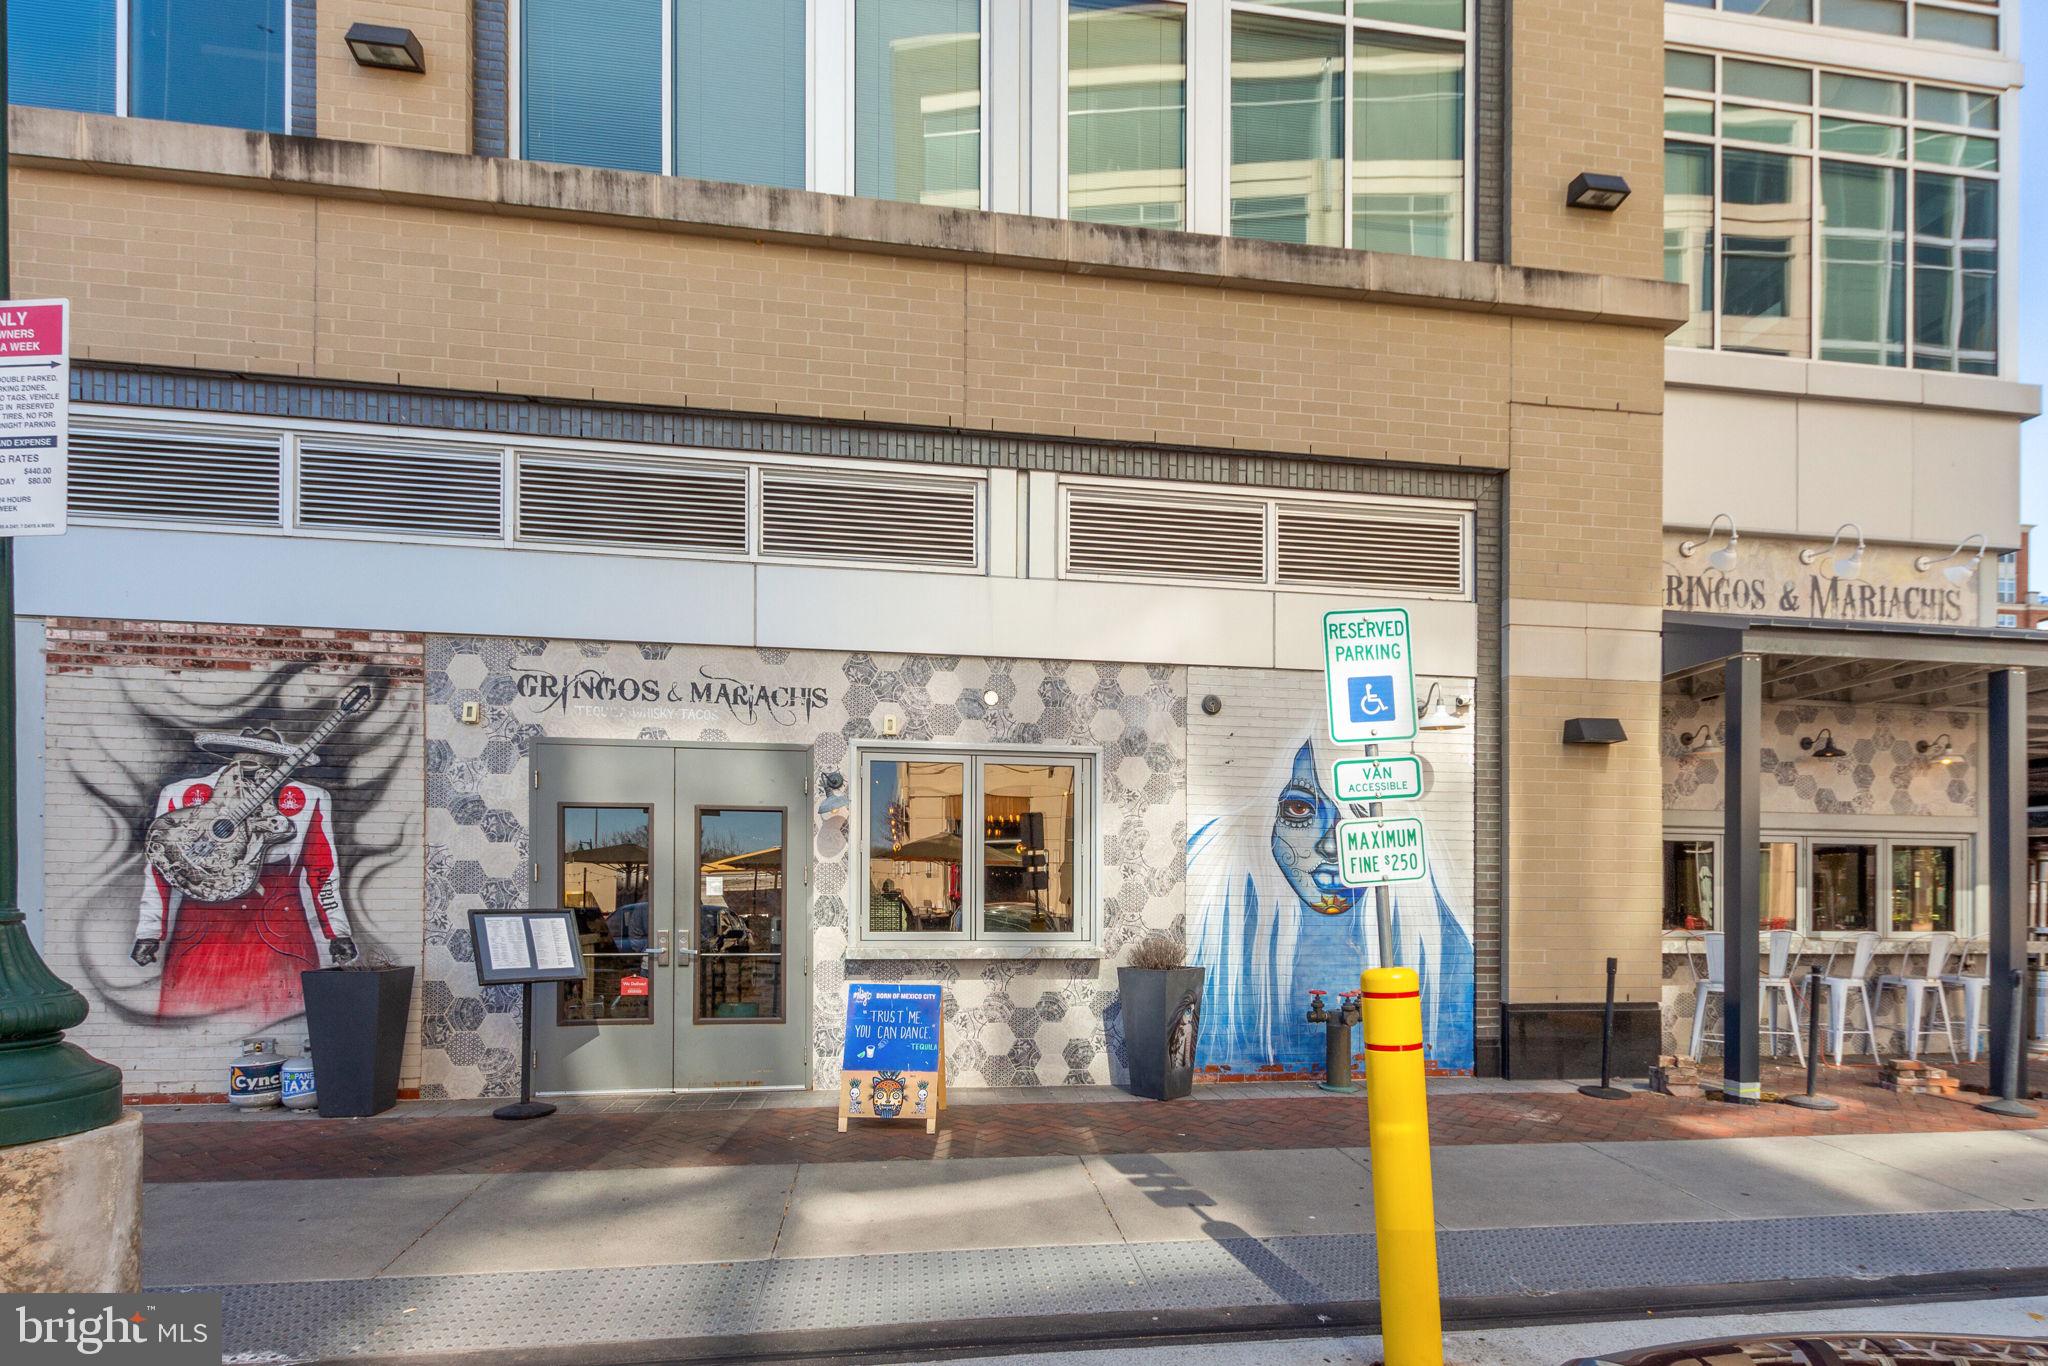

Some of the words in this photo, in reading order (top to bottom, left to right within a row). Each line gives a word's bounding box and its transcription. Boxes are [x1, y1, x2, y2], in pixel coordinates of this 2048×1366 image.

[1, 342, 8, 352] A
[10, 341, 40, 351] WEEK
[0, 375, 25, 383] OUBLE
[29, 392, 60, 400] VEHICLE
[17, 402, 55, 410] RESERVED
[39, 411, 53, 419] FOR
[24, 420, 56, 428] PARKING
[14, 438, 52, 447] EXPENSE
[8, 454, 40, 463] RATES
[24, 467, 52, 475] $440.00
[1662, 563, 1767, 613] RINGOS
[1779, 579, 1800, 612] &
[1329, 620, 1404, 640] RESERVED
[1335, 643, 1401, 662] PARKING
[510, 665, 660, 716] GRINGOS
[667, 681, 683, 702] &
[690, 666, 828, 726] MARIACHIS
[681, 708, 720, 722] TACOS
[1362, 767, 1393, 780] VAN
[1348, 781, 1408, 793] ACCESSIBLE
[1347, 828, 1417, 851] MAXIMUM
[1350, 856, 1380, 874] FINE
[1384, 853, 1418, 871] $250
[855, 1024, 871, 1038] YOU
[877, 1025, 897, 1039] CAN
[284, 1080, 315, 1093] TAXI
